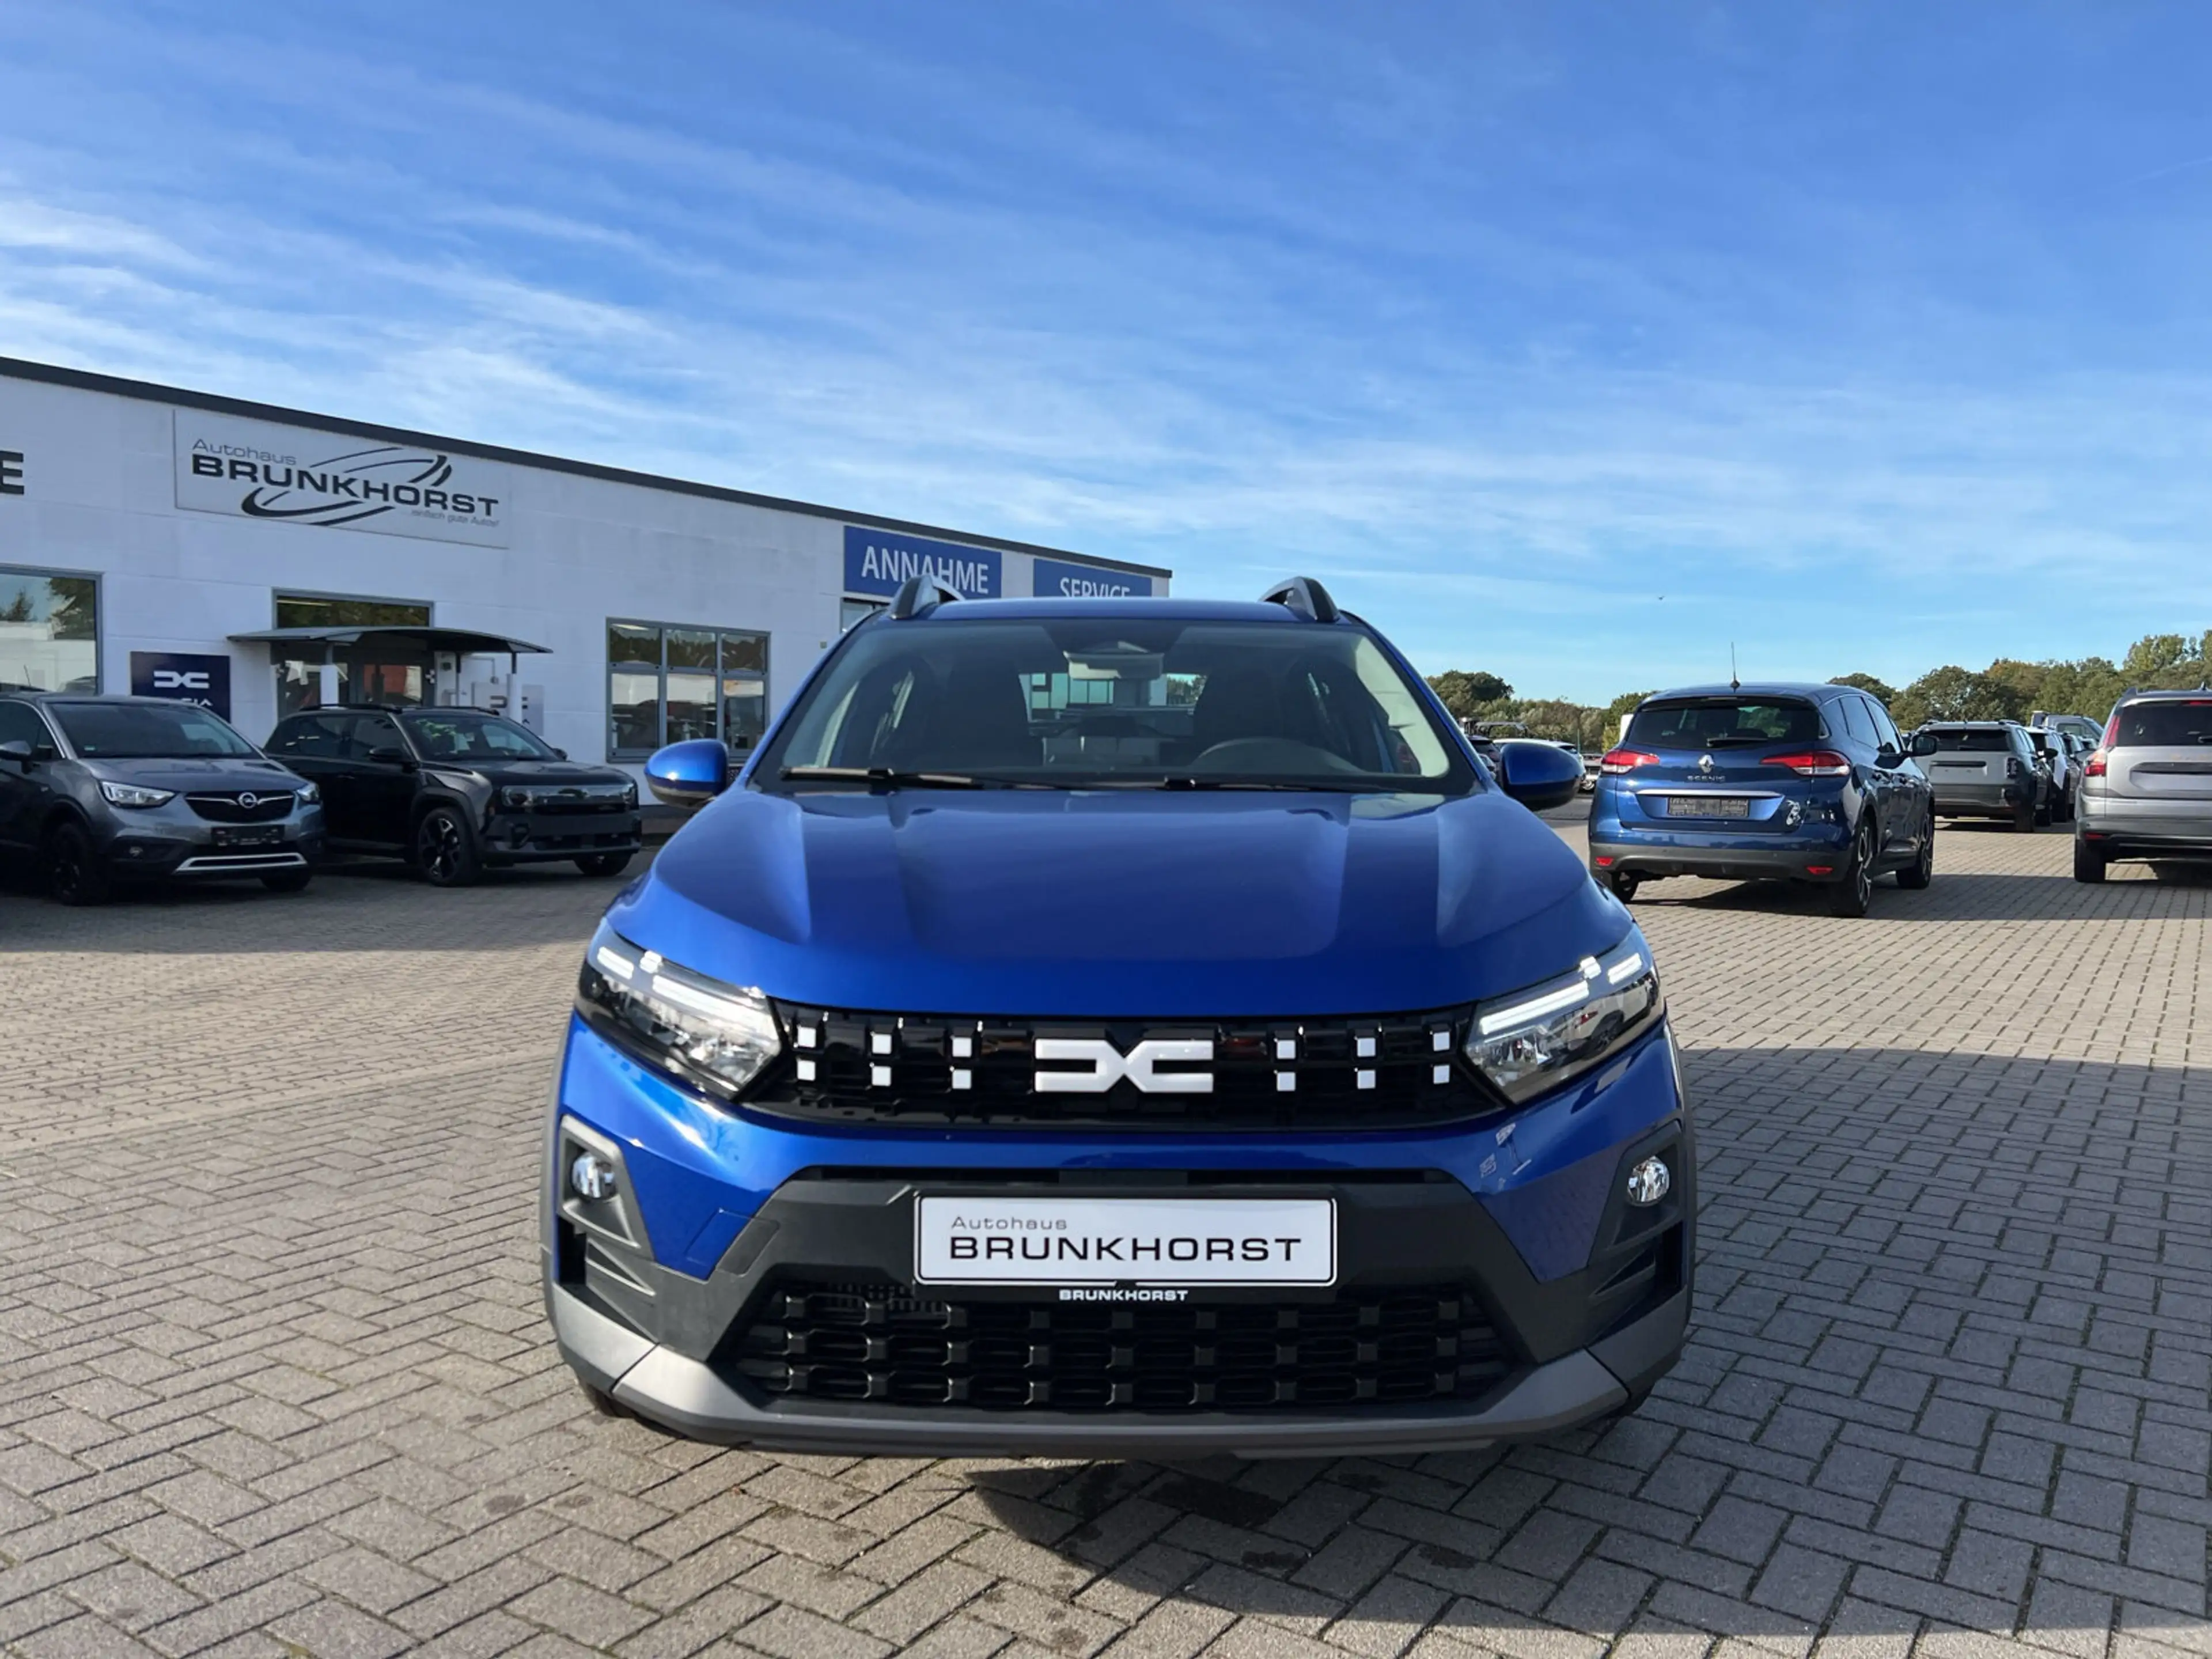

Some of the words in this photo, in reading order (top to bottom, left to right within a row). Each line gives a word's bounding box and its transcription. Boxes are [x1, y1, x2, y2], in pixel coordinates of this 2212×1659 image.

[192, 438, 297, 465] Autohaus
[192, 453, 499, 517] BRUNKHORST
[861, 546, 989, 594] ANNAHME
[950, 1216, 1067, 1230] Autohaus
[950, 1237, 1302, 1262] BRUNKHORST
[1059, 1289, 1189, 1301] BRUNKHORST
